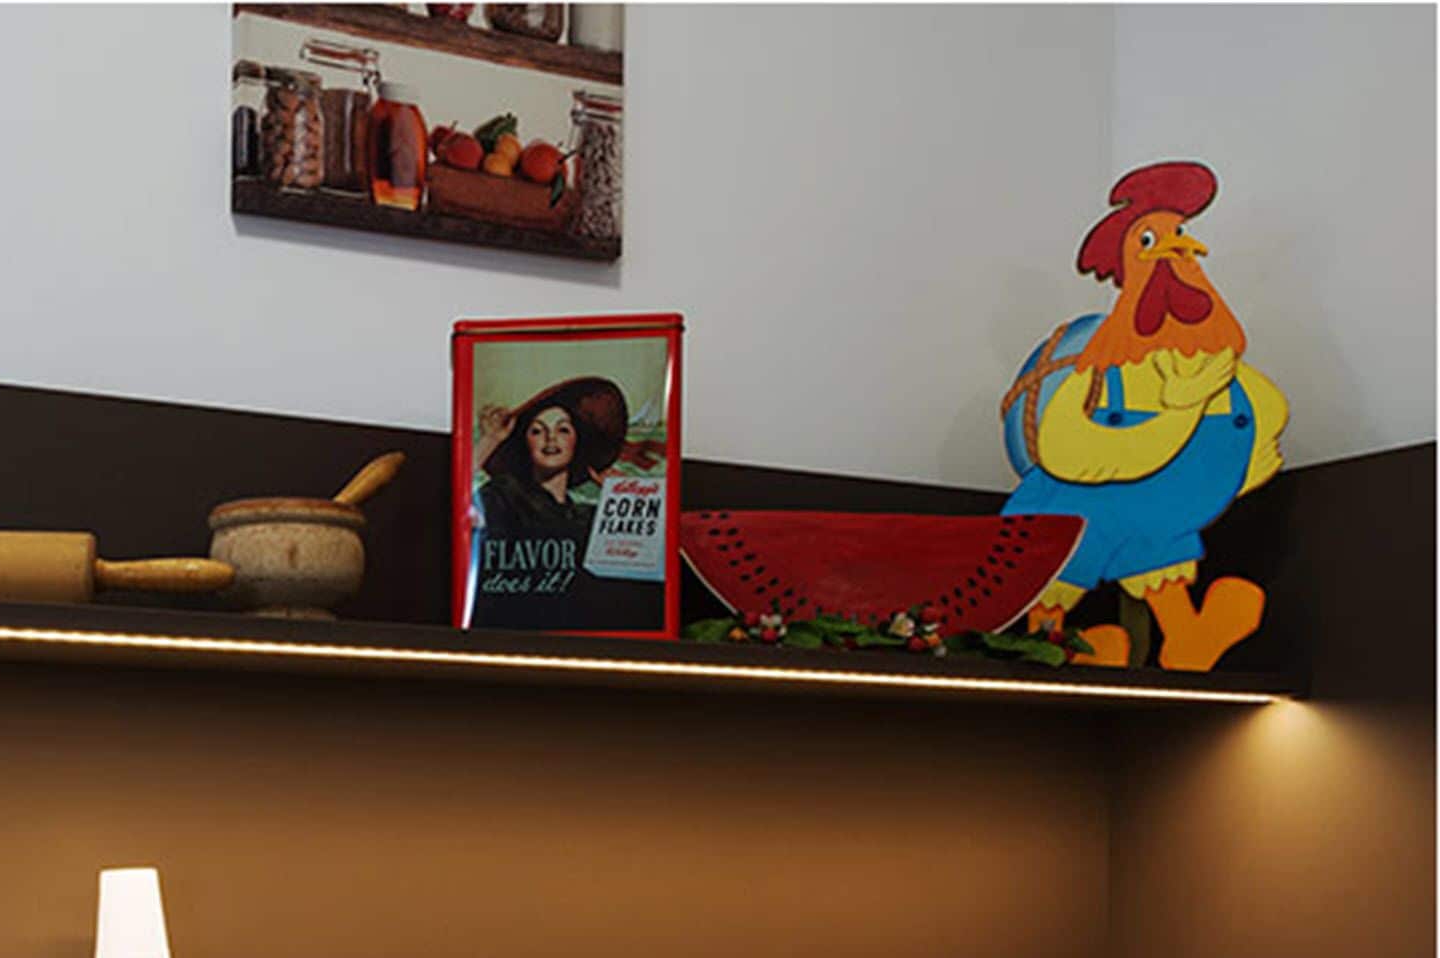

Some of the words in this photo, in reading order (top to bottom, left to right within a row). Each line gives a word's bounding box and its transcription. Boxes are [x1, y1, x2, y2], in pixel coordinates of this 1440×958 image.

[602, 497, 662, 519] CORN
[598, 519, 657, 536] FLAKES
[485, 538, 577, 570] FLAVOR
[482, 571, 531, 593] does
[537, 570, 575, 593] it!
